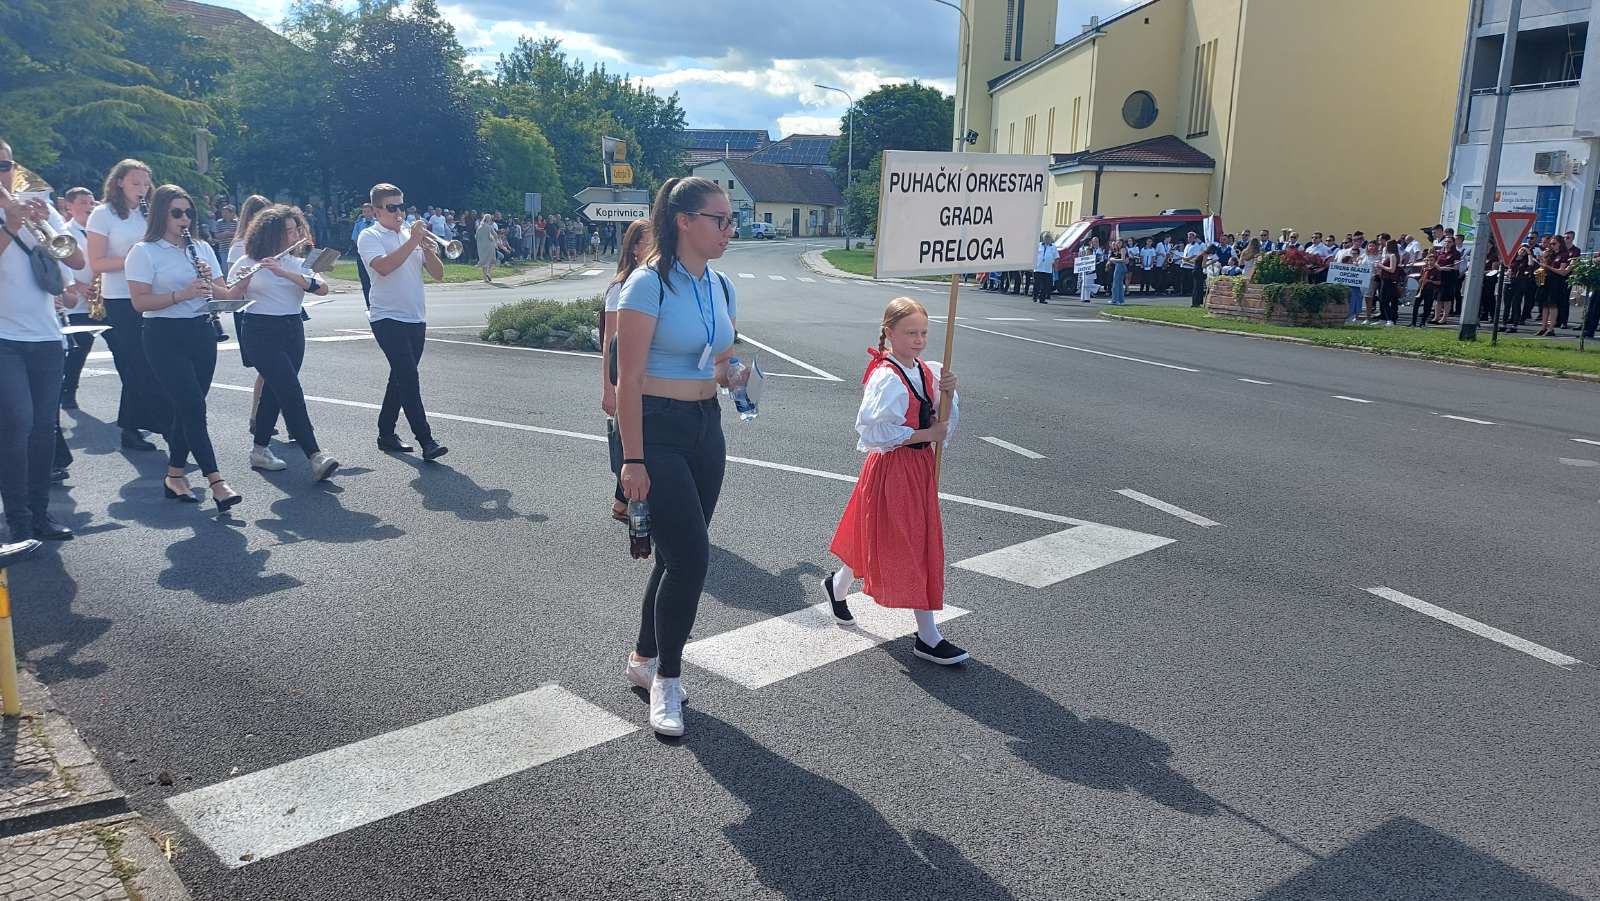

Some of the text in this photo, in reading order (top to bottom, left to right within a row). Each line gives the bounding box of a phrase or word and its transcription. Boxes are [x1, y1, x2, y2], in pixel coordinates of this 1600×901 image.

[889, 166, 1044, 193] PUHAČKI ORKESTAR
[596, 207, 644, 218] Koprivnica
[939, 206, 993, 226] GRADA
[919, 237, 1005, 263] PRELOGA
